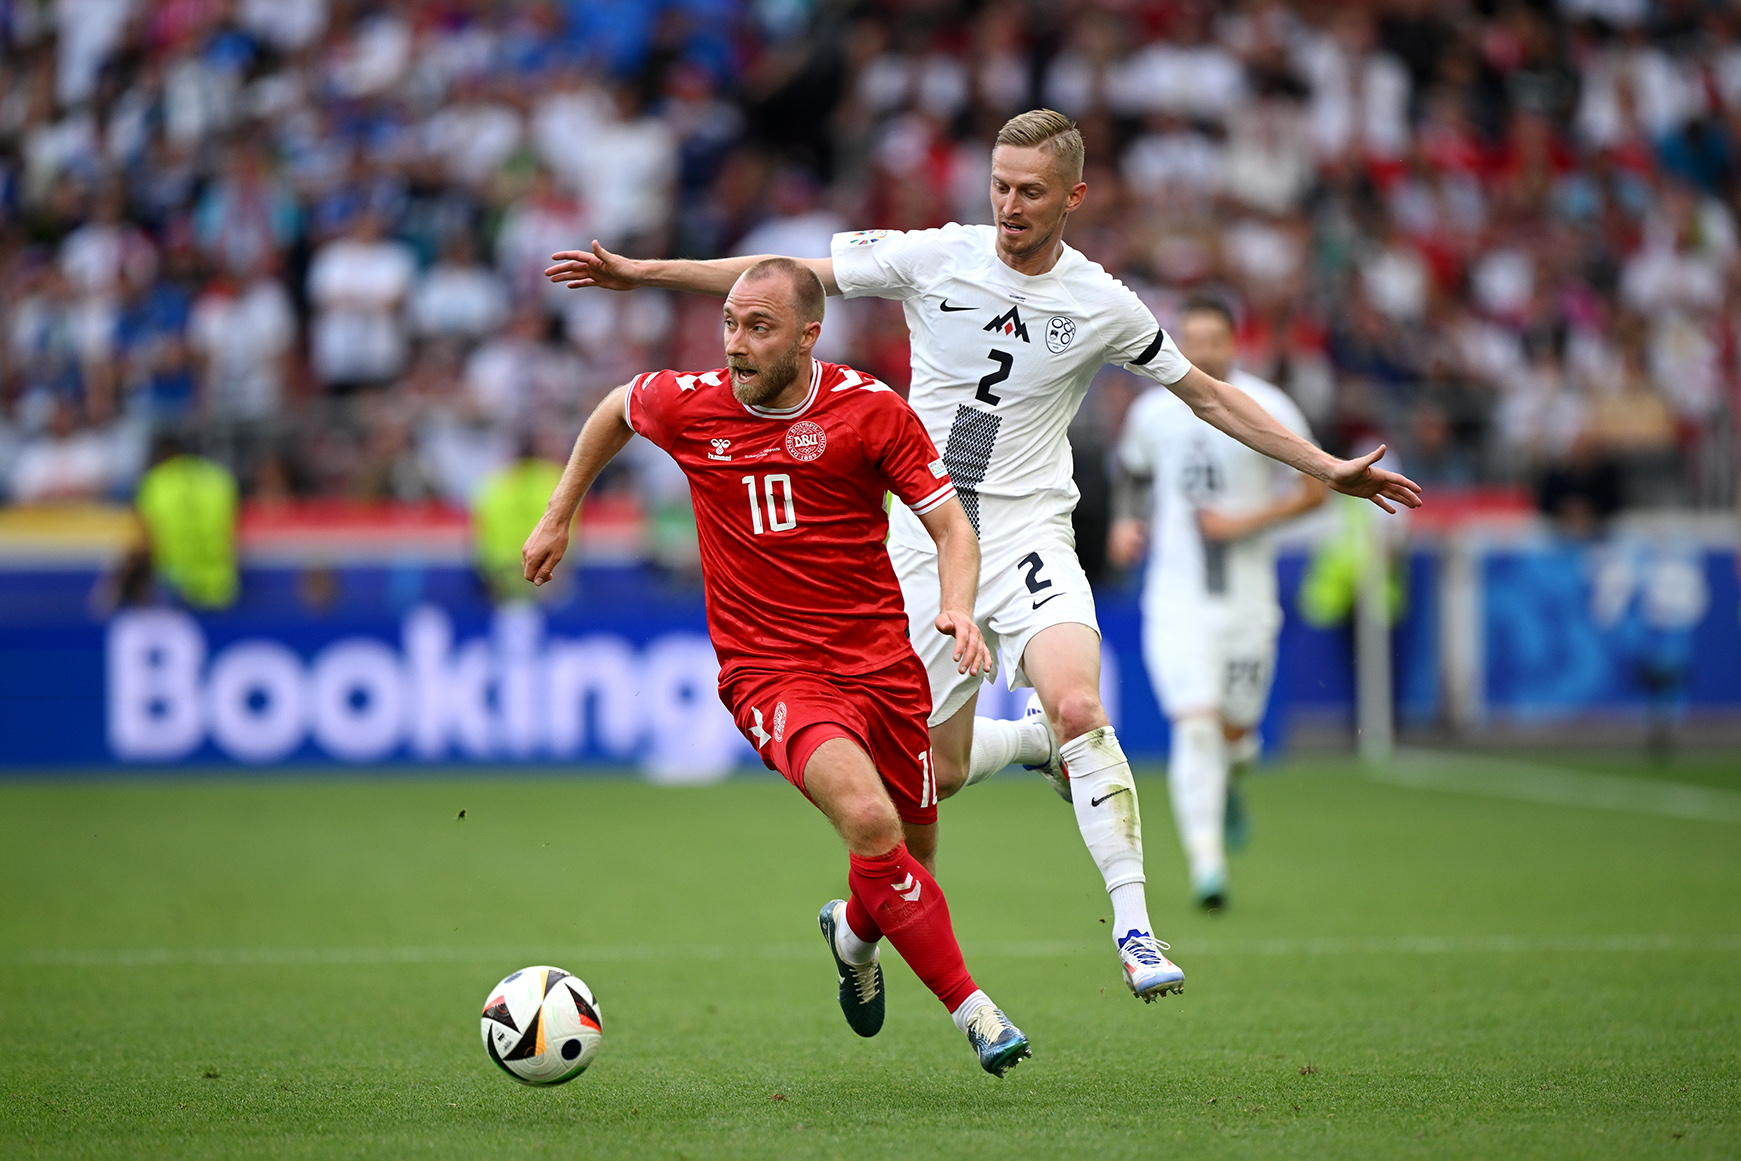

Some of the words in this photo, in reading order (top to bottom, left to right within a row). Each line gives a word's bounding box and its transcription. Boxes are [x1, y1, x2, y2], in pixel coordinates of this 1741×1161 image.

[975, 348, 1014, 407] 2
[794, 433, 819, 448] DBU
[742, 473, 797, 535] 10
[1017, 551, 1052, 594] 2
[108, 602, 740, 783] Booking
